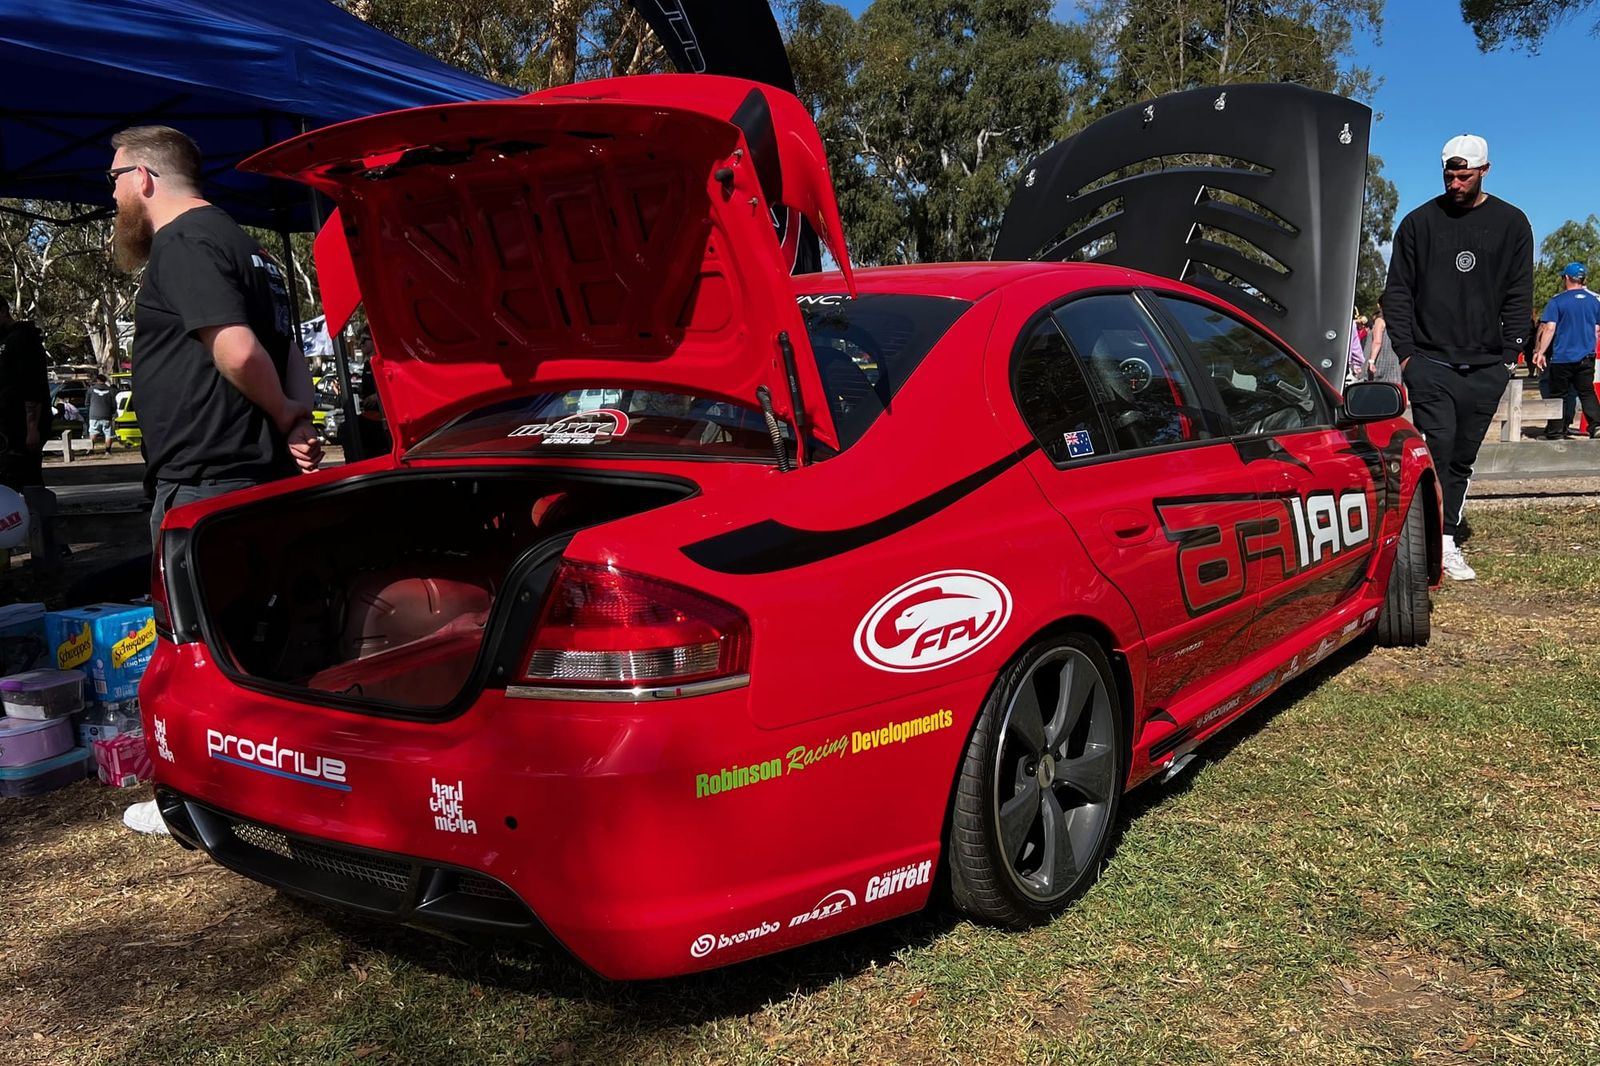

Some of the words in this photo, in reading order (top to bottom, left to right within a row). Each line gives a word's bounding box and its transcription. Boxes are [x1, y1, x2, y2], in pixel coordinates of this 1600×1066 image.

[114, 629, 153, 661] Schweppes
[911, 610, 996, 659] FPV
[60, 640, 91, 668] Schweppes
[207, 729, 346, 782] prodrive
[696, 758, 782, 798] Robinson
[786, 734, 850, 775] Racing
[852, 709, 953, 754] Developments
[431, 777, 464, 801] hard
[434, 810, 478, 835] media
[865, 860, 932, 902] Garrett
[717, 921, 781, 950] brembo
